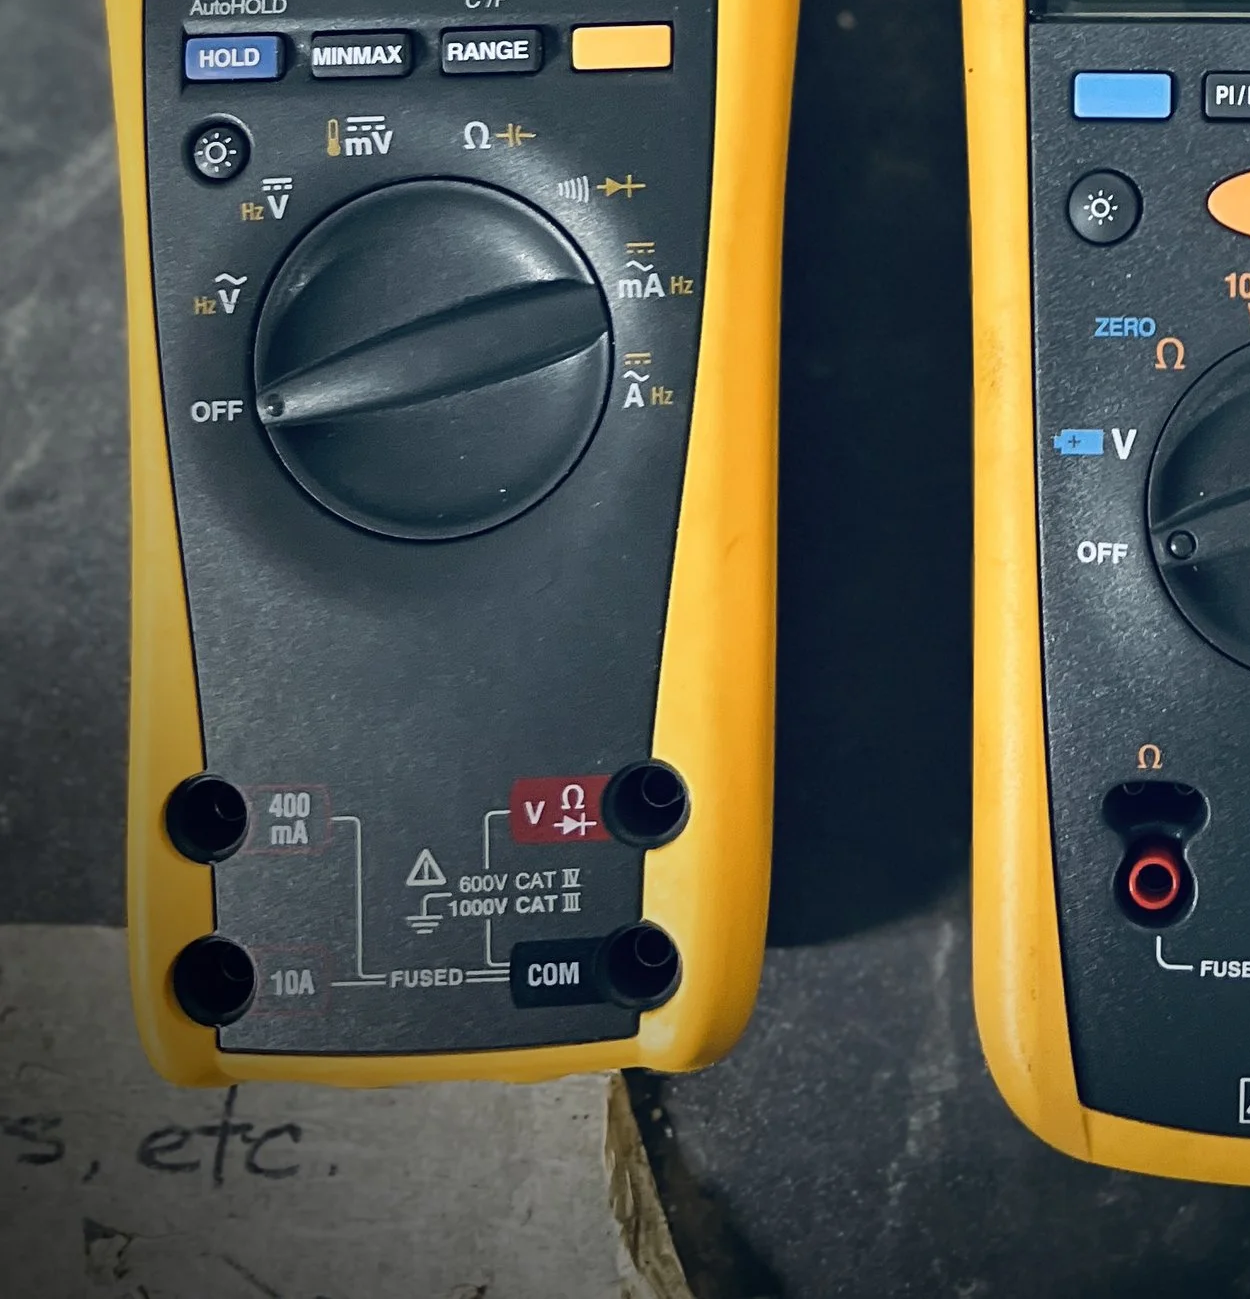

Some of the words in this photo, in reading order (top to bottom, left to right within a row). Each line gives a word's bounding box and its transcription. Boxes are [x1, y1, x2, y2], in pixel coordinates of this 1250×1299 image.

[199, 47, 260, 68] HOLD
[312, 45, 402, 66] MINMAX
[448, 41, 529, 61] RANGE
[345, 130, 393, 156] mV
[241, 203, 264, 221] Hz
[619, 273, 665, 298] mA
[670, 277, 694, 295] Hz
[194, 296, 216, 315] Hz
[1095, 317, 1157, 337] ZERO
[652, 386, 673, 405] Hz
[191, 400, 243, 422] OFF
[1111, 430, 1136, 459] V
[1077, 542, 1128, 564] OFF
[269, 792, 310, 819] 400
[524, 801, 545, 825] V
[271, 822, 308, 846] mA
[459, 872, 508, 893] 600V
[515, 870, 557, 891] CAT
[561, 868, 581, 889] IV
[449, 896, 508, 917] 1000V
[515, 894, 557, 915] CAT
[562, 892, 581, 913] III
[270, 969, 314, 996] 10A
[390, 967, 463, 988] FUSED
[528, 963, 579, 986] COM
[137, 1085, 340, 1188] etc.
